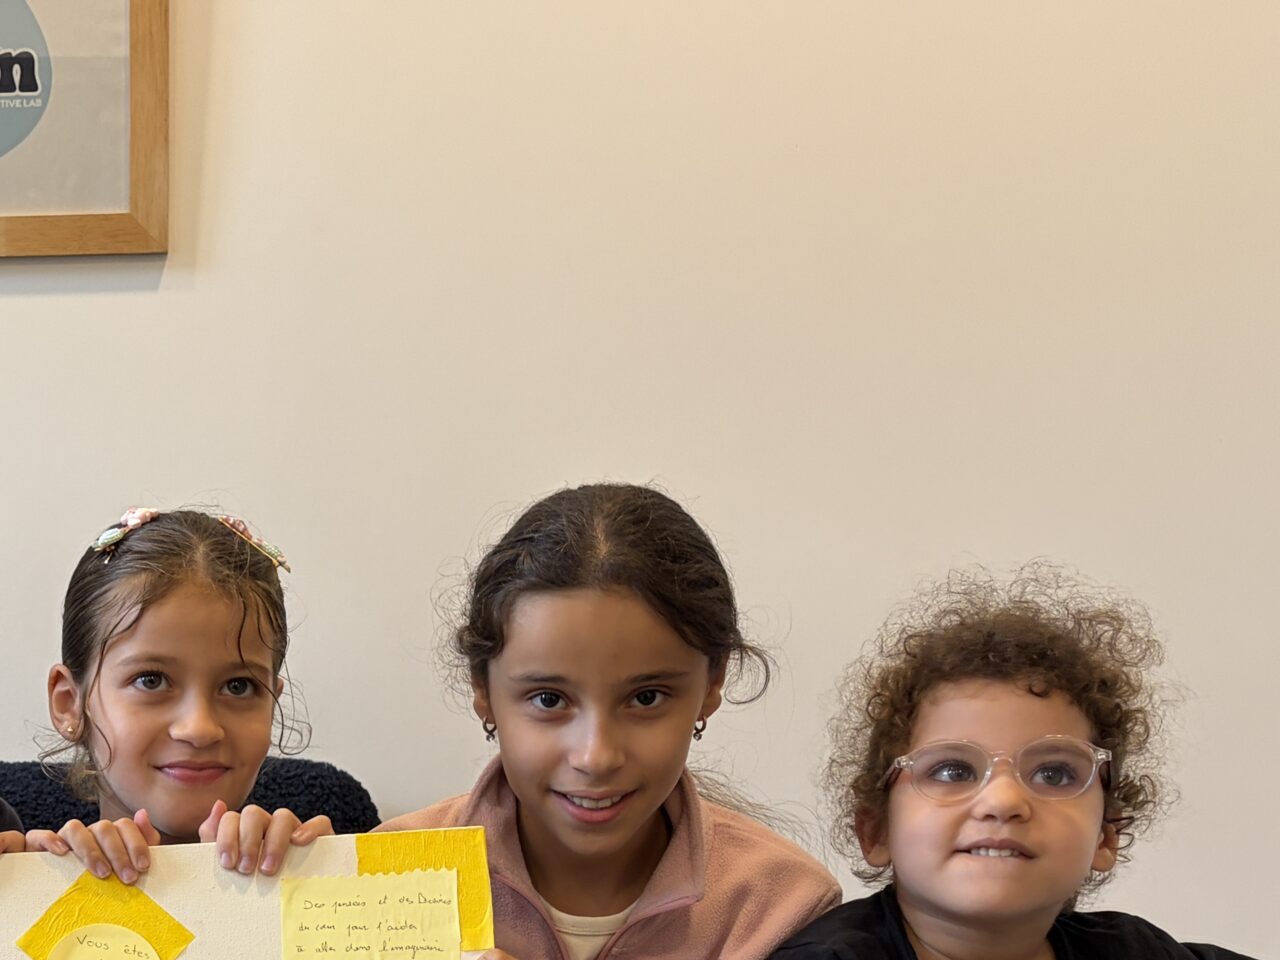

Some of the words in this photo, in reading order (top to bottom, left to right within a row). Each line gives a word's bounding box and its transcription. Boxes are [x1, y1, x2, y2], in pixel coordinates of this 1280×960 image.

[23, 98, 42, 108] LAB
[76, 934, 110, 951] Vous
[123, 944, 150, 960] êtes
